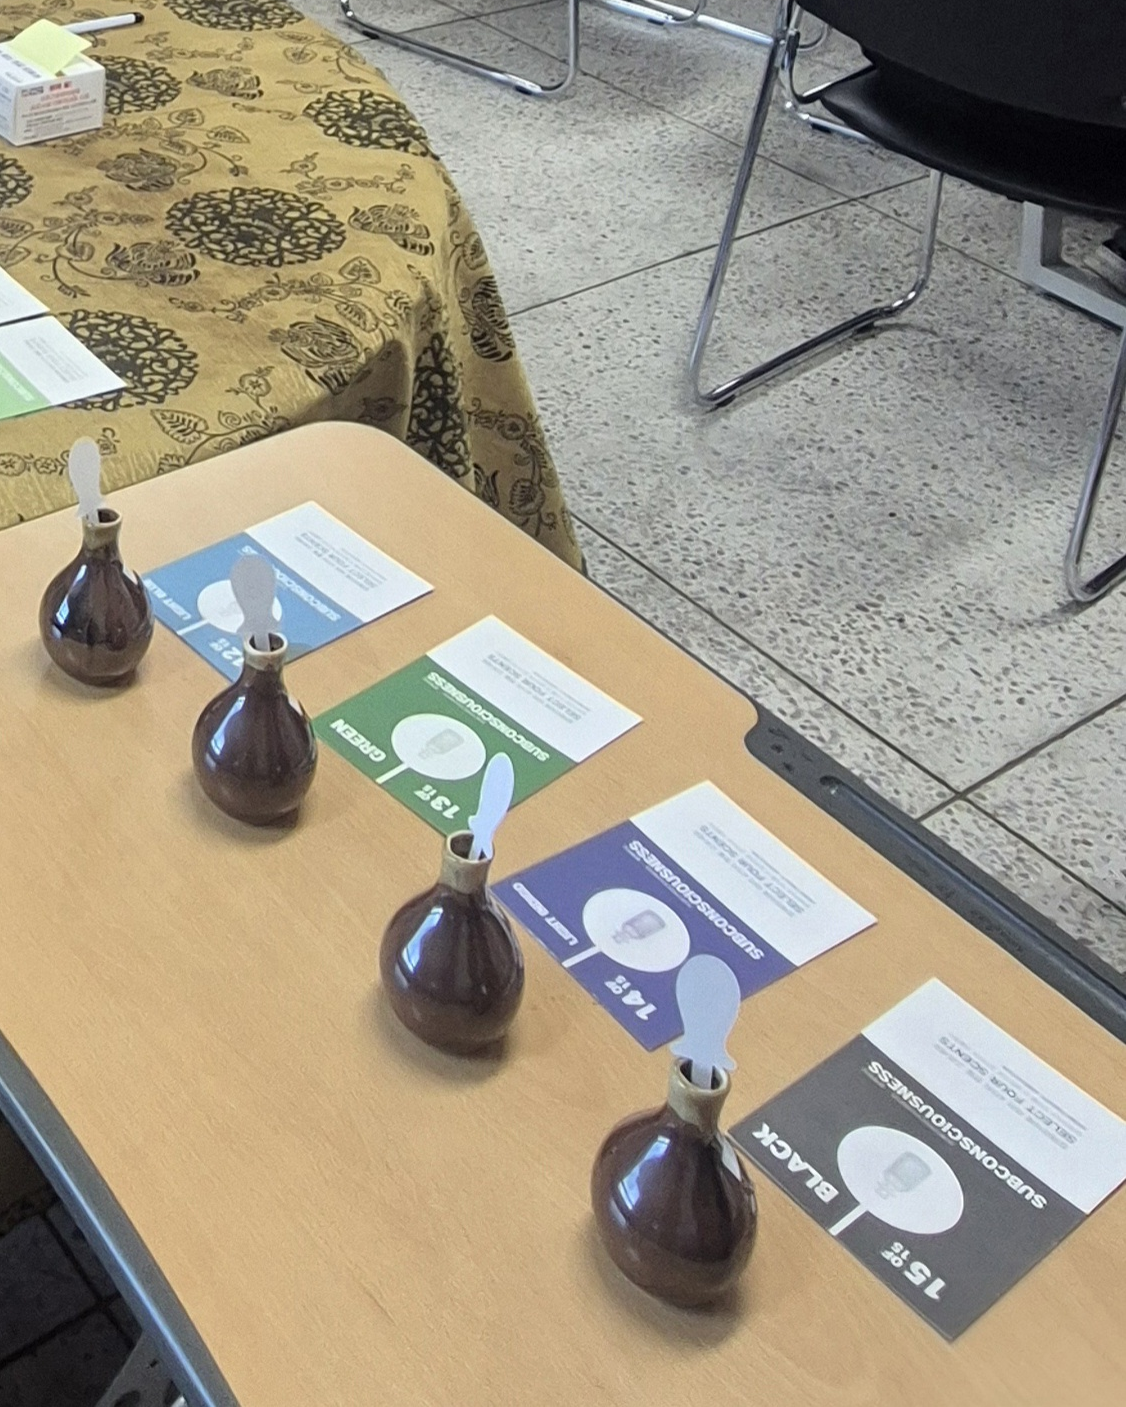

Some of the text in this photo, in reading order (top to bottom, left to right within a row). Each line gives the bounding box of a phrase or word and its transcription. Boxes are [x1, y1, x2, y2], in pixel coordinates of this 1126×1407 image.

[240, 545, 341, 622] SUBCONSCIOS
[219, 646, 249, 668] 12
[425, 671, 551, 762] SUBCONSCIOUSNESS
[328, 717, 388, 763] GREEN
[427, 794, 461, 819] 13
[626, 839, 765, 960] SUBCONSCIOUSNESS
[618, 988, 657, 1021] 14
[938, 1035, 988, 1076] SCENTS
[990, 1076, 1023, 1105] FOUR
[867, 1059, 1047, 1209] SUBCONSCIOUSNESS
[1026, 1105, 1076, 1144] SELECT
[750, 1121, 840, 1203] BLACK
[880, 1240, 945, 1301] 15 OF 15
